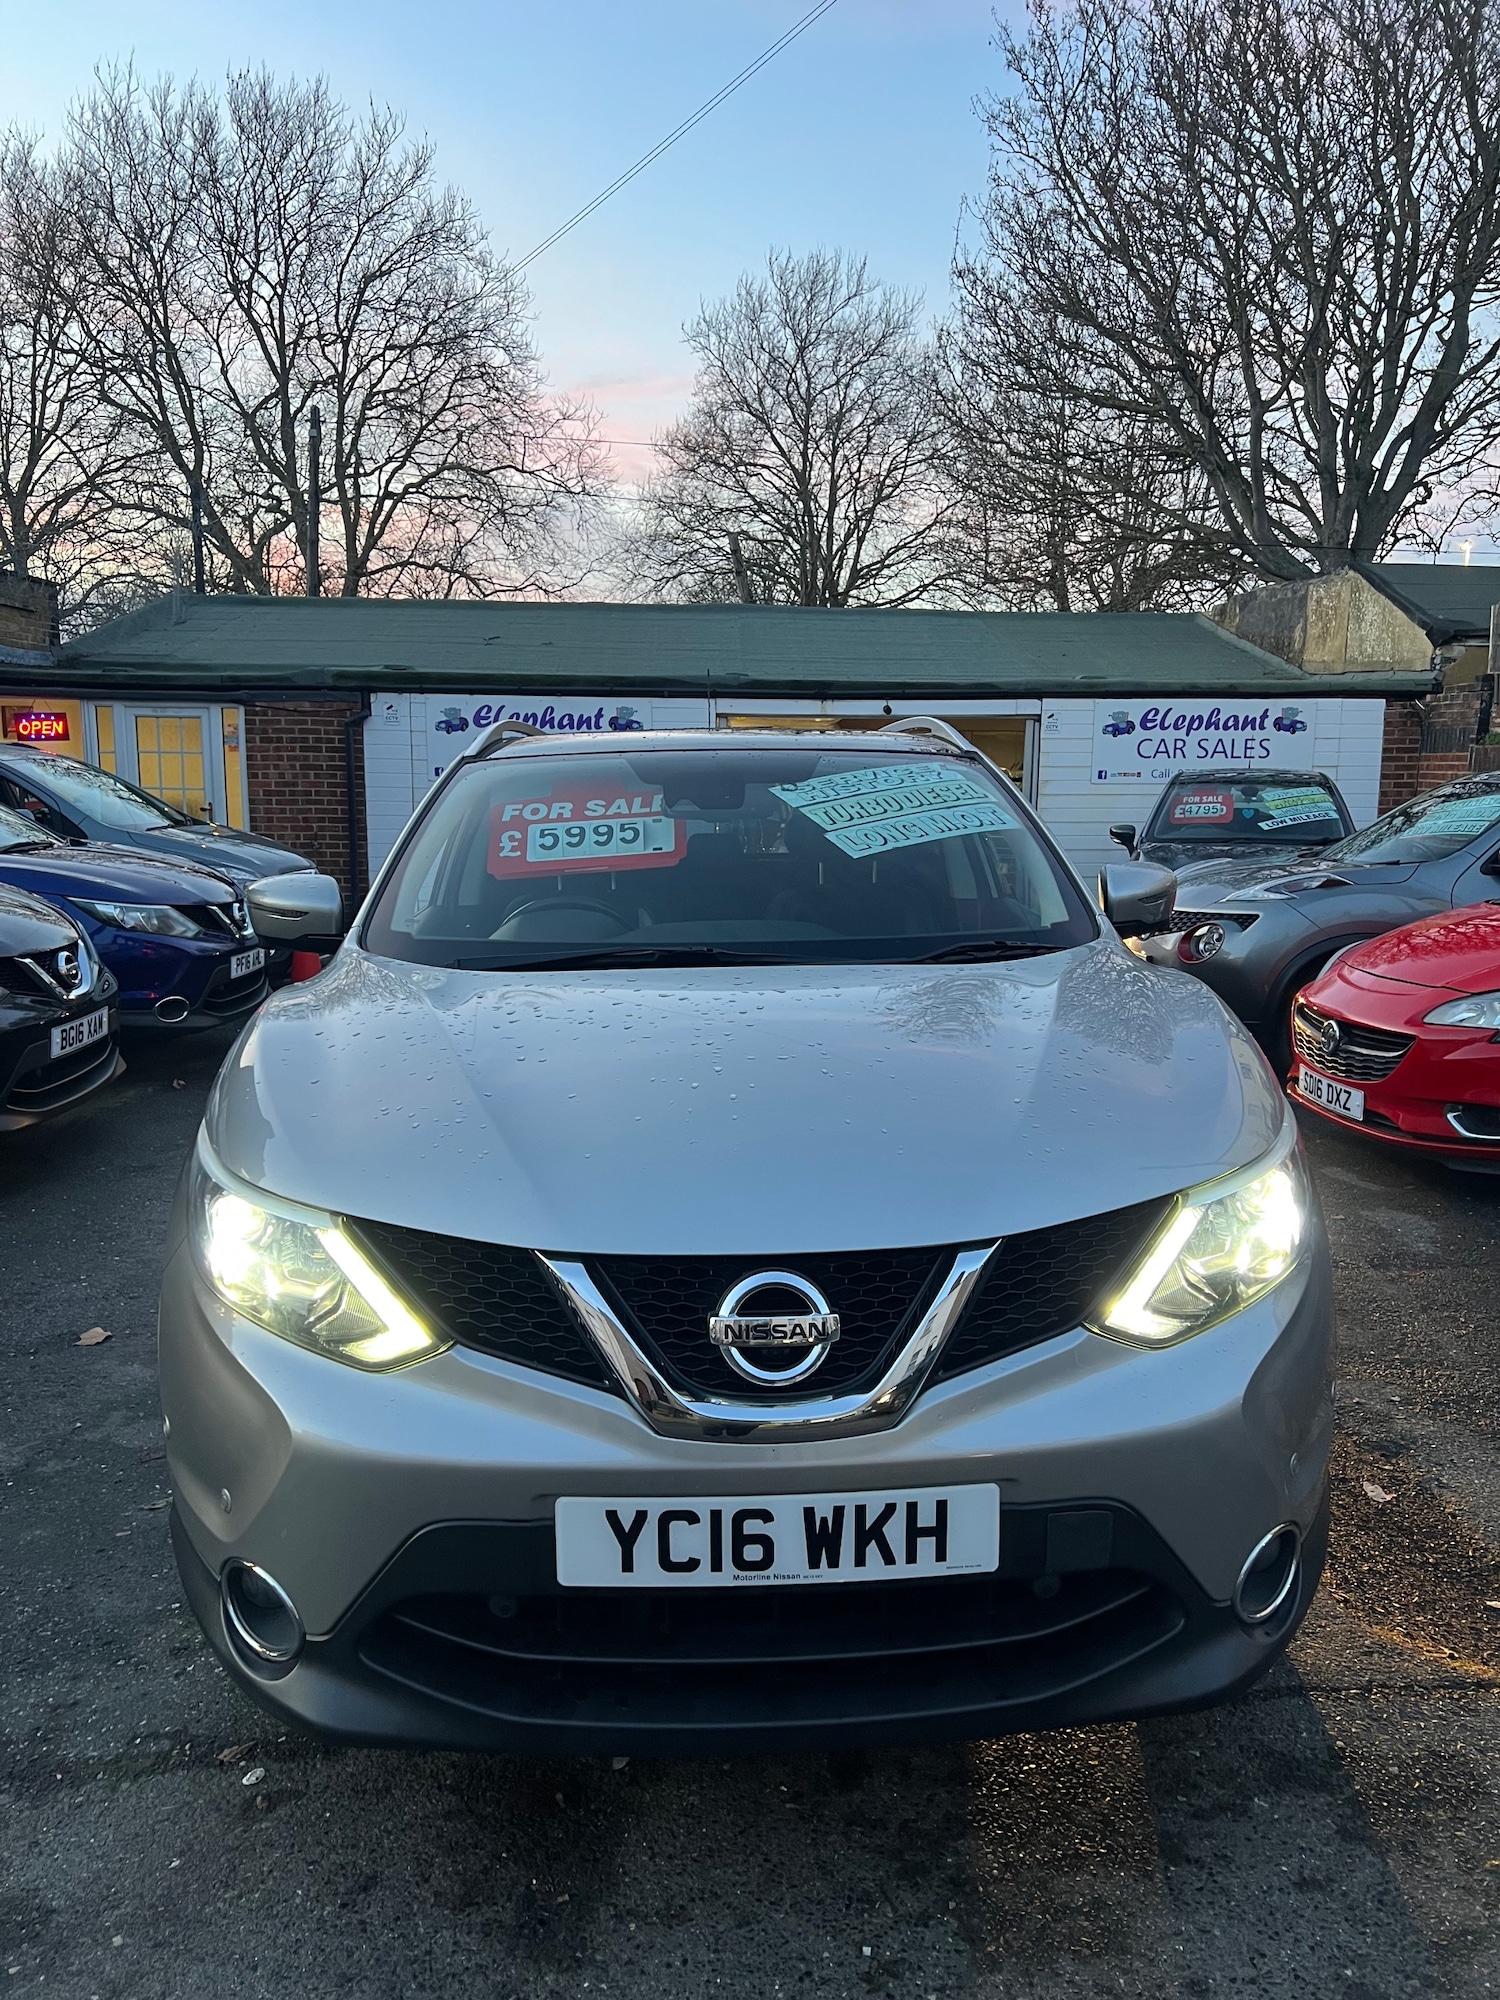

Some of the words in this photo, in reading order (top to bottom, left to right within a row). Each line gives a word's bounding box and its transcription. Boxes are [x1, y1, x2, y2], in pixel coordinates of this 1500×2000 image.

[19, 720, 63, 736] OPEN
[1139, 707, 1270, 738] Elephant
[1136, 738, 1187, 759] CAR
[1196, 738, 1271, 759] SALES
[501, 801, 574, 822] FOR
[809, 783, 989, 826] TURBODIESEL
[1182, 796, 1200, 804] FOR
[1201, 795, 1223, 803] SALE
[1265, 819, 1288, 828] LOW
[1289, 811, 1333, 823] MILEAGE
[537, 822, 641, 851] 5995
[836, 817, 930, 852] LONG
[60, 1021, 84, 1051] BG16
[1303, 1071, 1323, 1100] SD16
[1326, 1082, 1352, 1112] DXZ
[724, 1321, 827, 1340] NISSAN
[605, 1508, 775, 1573] YC16
[802, 1499, 948, 1570] WKH
[732, 1574, 771, 1582] Motorline
